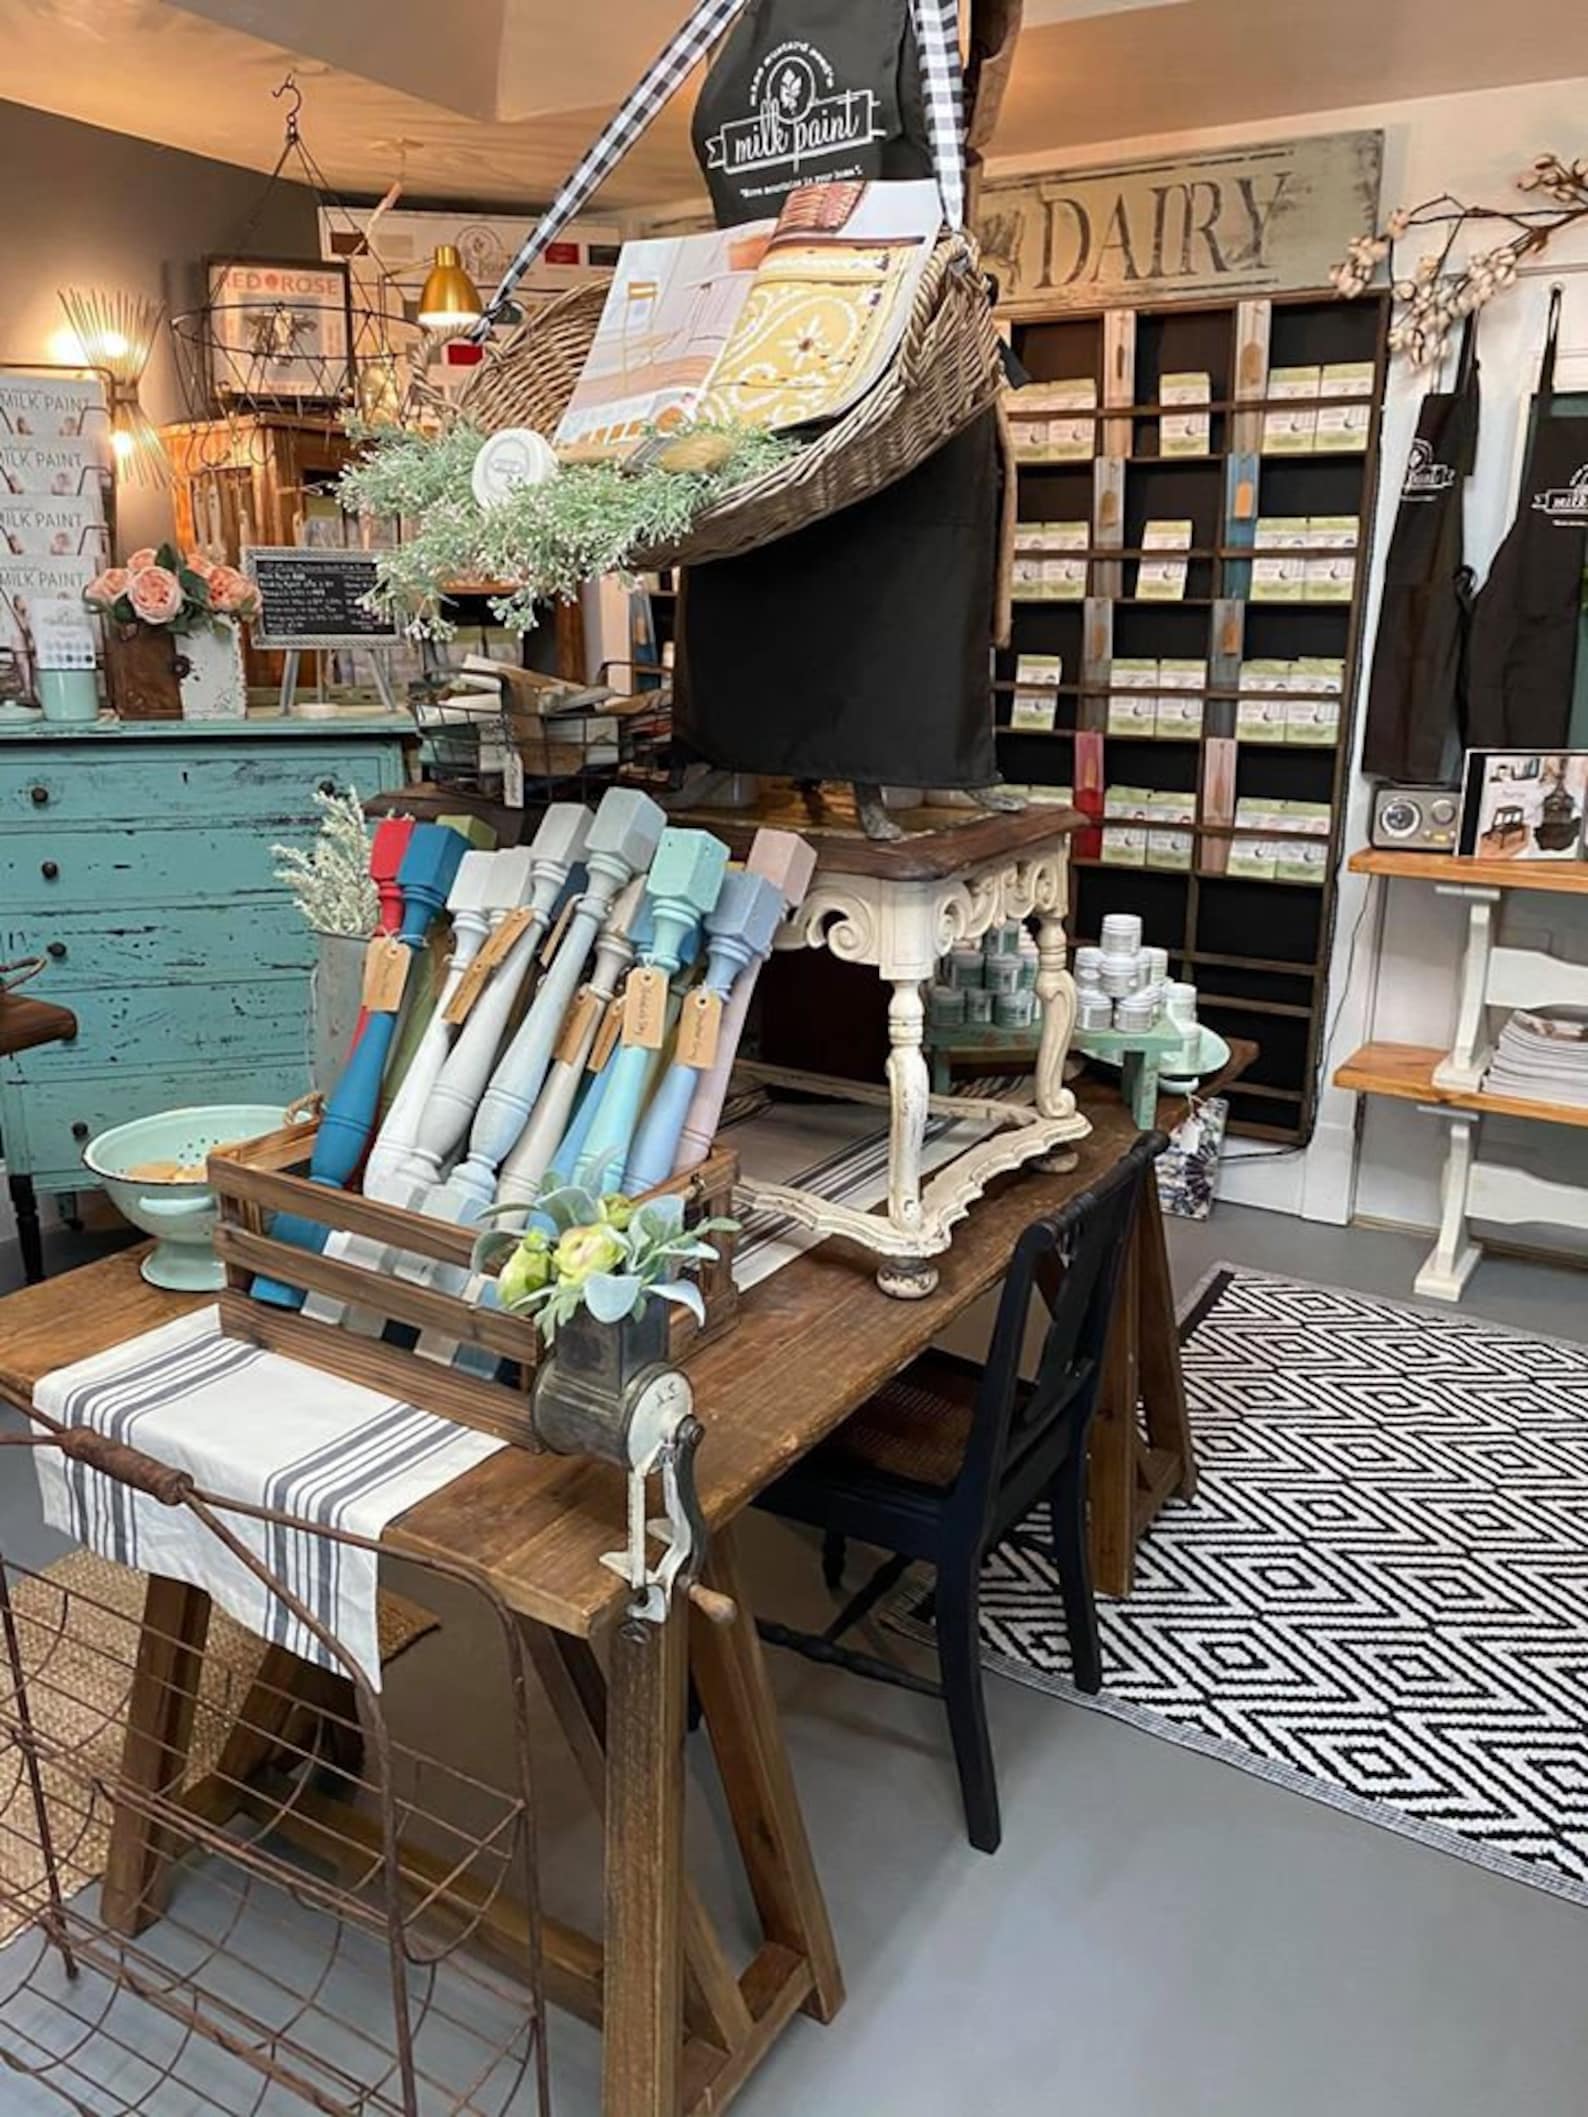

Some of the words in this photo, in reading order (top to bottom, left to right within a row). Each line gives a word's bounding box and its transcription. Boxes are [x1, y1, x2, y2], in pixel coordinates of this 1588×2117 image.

[735, 98, 789, 164] milk
[793, 89, 861, 174] paint
[1033, 171, 1292, 290] DAIRY
[281, 275, 338, 296] ROSE
[35, 451, 81, 468] PAINT
[35, 511, 81, 528] PAINT
[40, 571, 84, 588] PAINT
